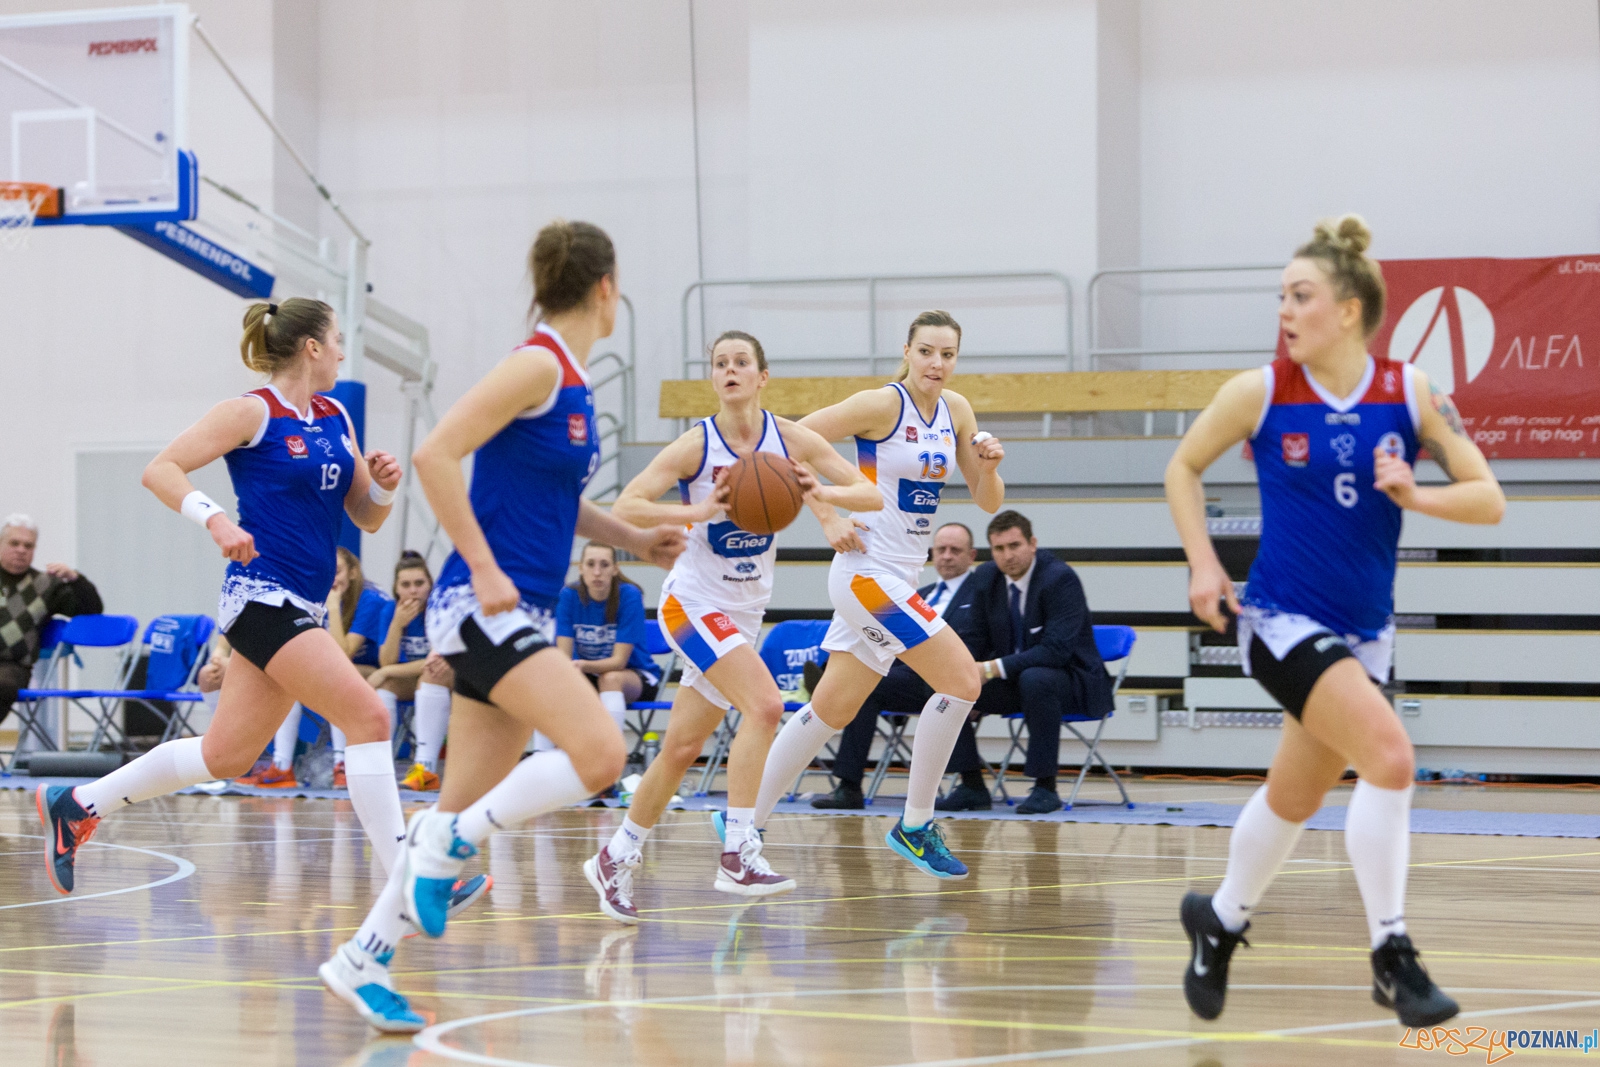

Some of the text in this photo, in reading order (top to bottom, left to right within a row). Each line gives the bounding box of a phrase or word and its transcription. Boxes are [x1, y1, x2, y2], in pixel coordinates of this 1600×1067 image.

[154, 220, 253, 281] PESMENPOL
[1500, 334, 1583, 370] ALFA
[1529, 428, 1553, 444] hip
[1554, 428, 1584, 443] hop
[320, 463, 341, 490] 19
[918, 451, 948, 479] 13
[1333, 473, 1358, 508] 6
[726, 537, 768, 549] Enea
